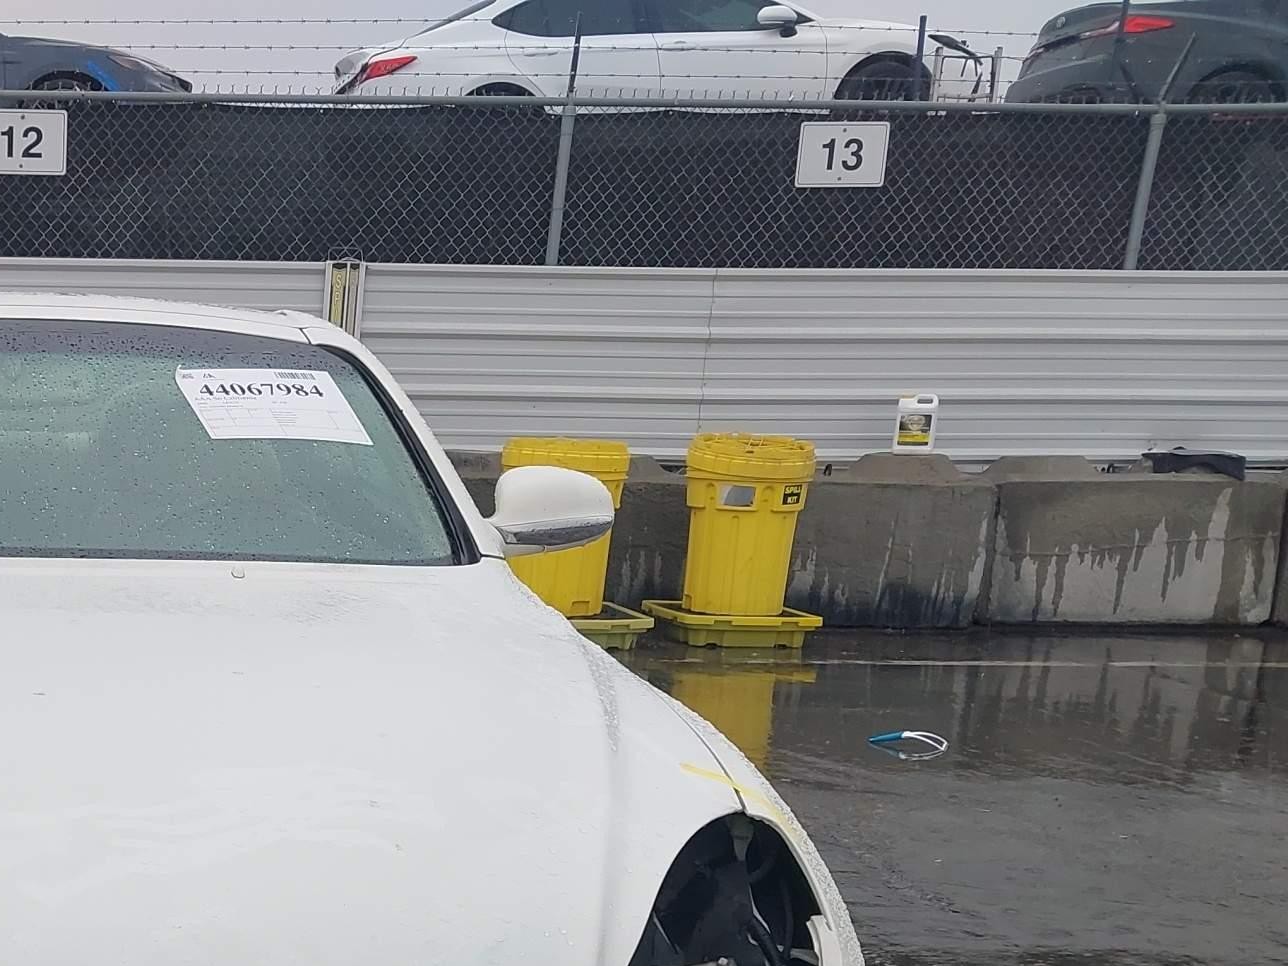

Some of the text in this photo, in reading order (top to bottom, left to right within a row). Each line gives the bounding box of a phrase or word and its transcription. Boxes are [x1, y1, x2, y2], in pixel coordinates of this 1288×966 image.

[0, 125, 44, 159] 12
[822, 138, 865, 171] 13
[199, 382, 324, 397] 44067984
